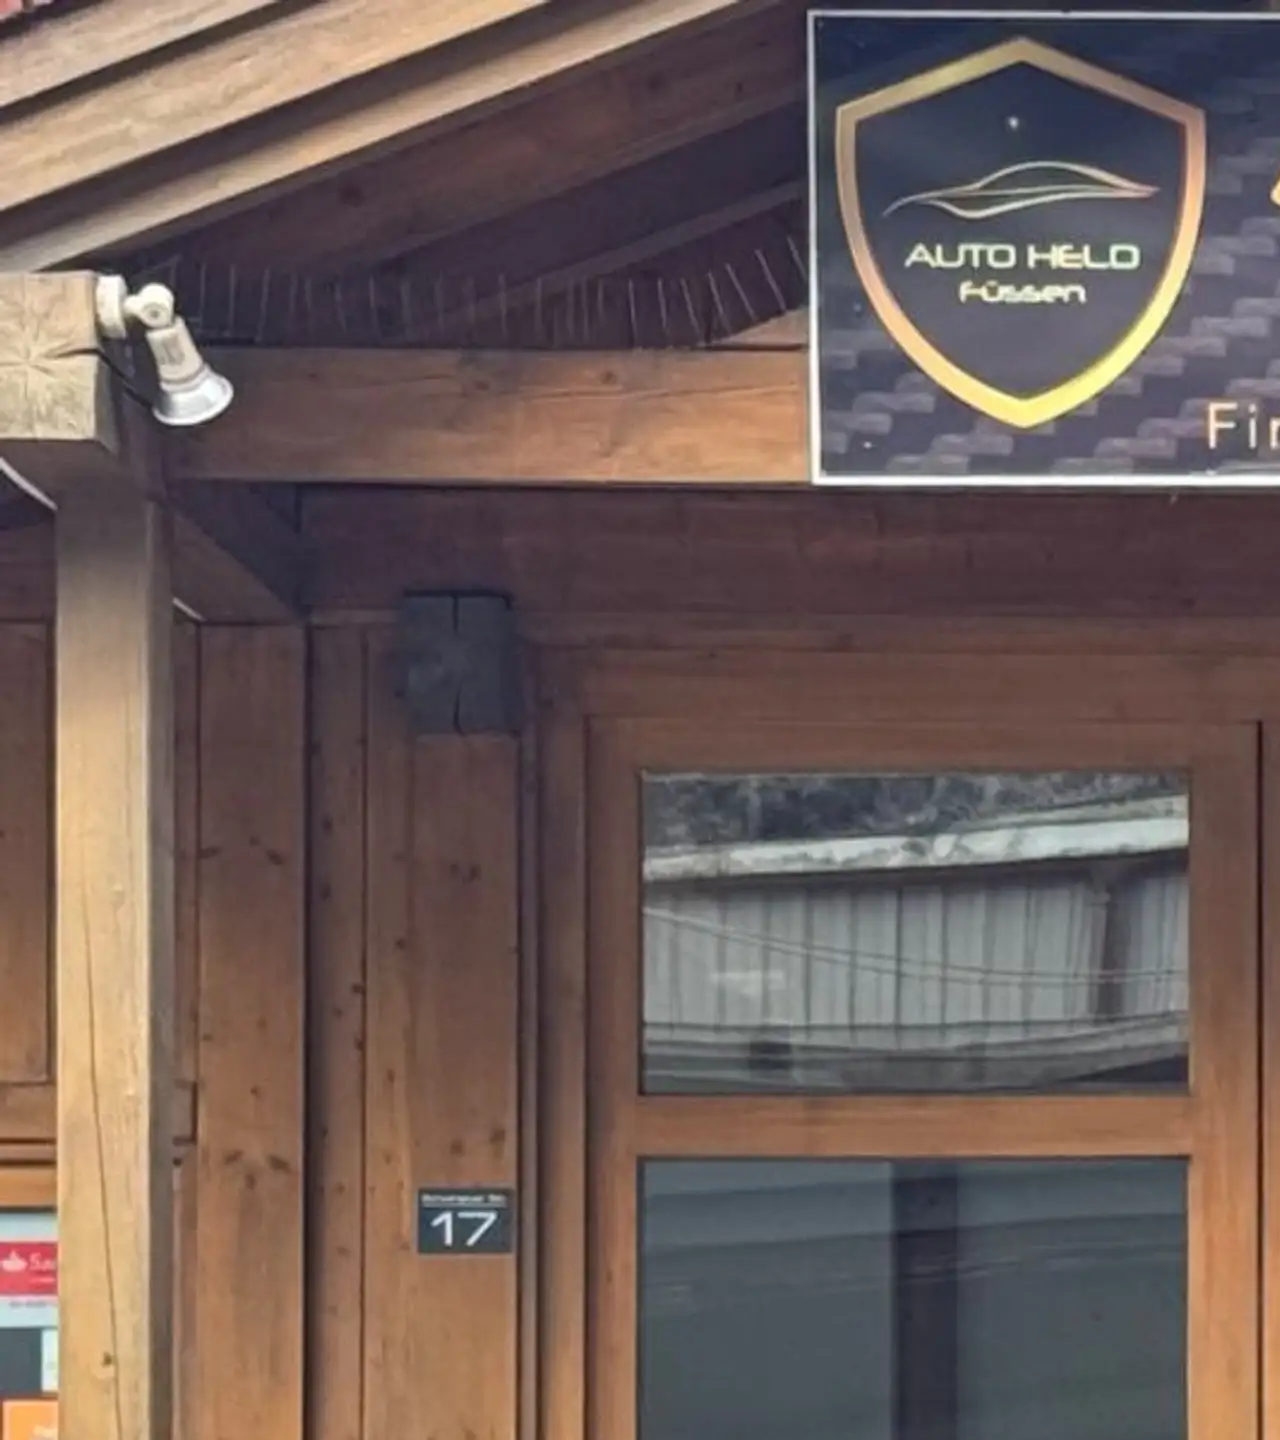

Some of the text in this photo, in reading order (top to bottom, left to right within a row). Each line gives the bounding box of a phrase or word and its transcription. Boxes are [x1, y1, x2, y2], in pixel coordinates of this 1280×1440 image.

[904, 242, 1141, 270] AUTO HELD
[430, 1209, 499, 1248] 17
